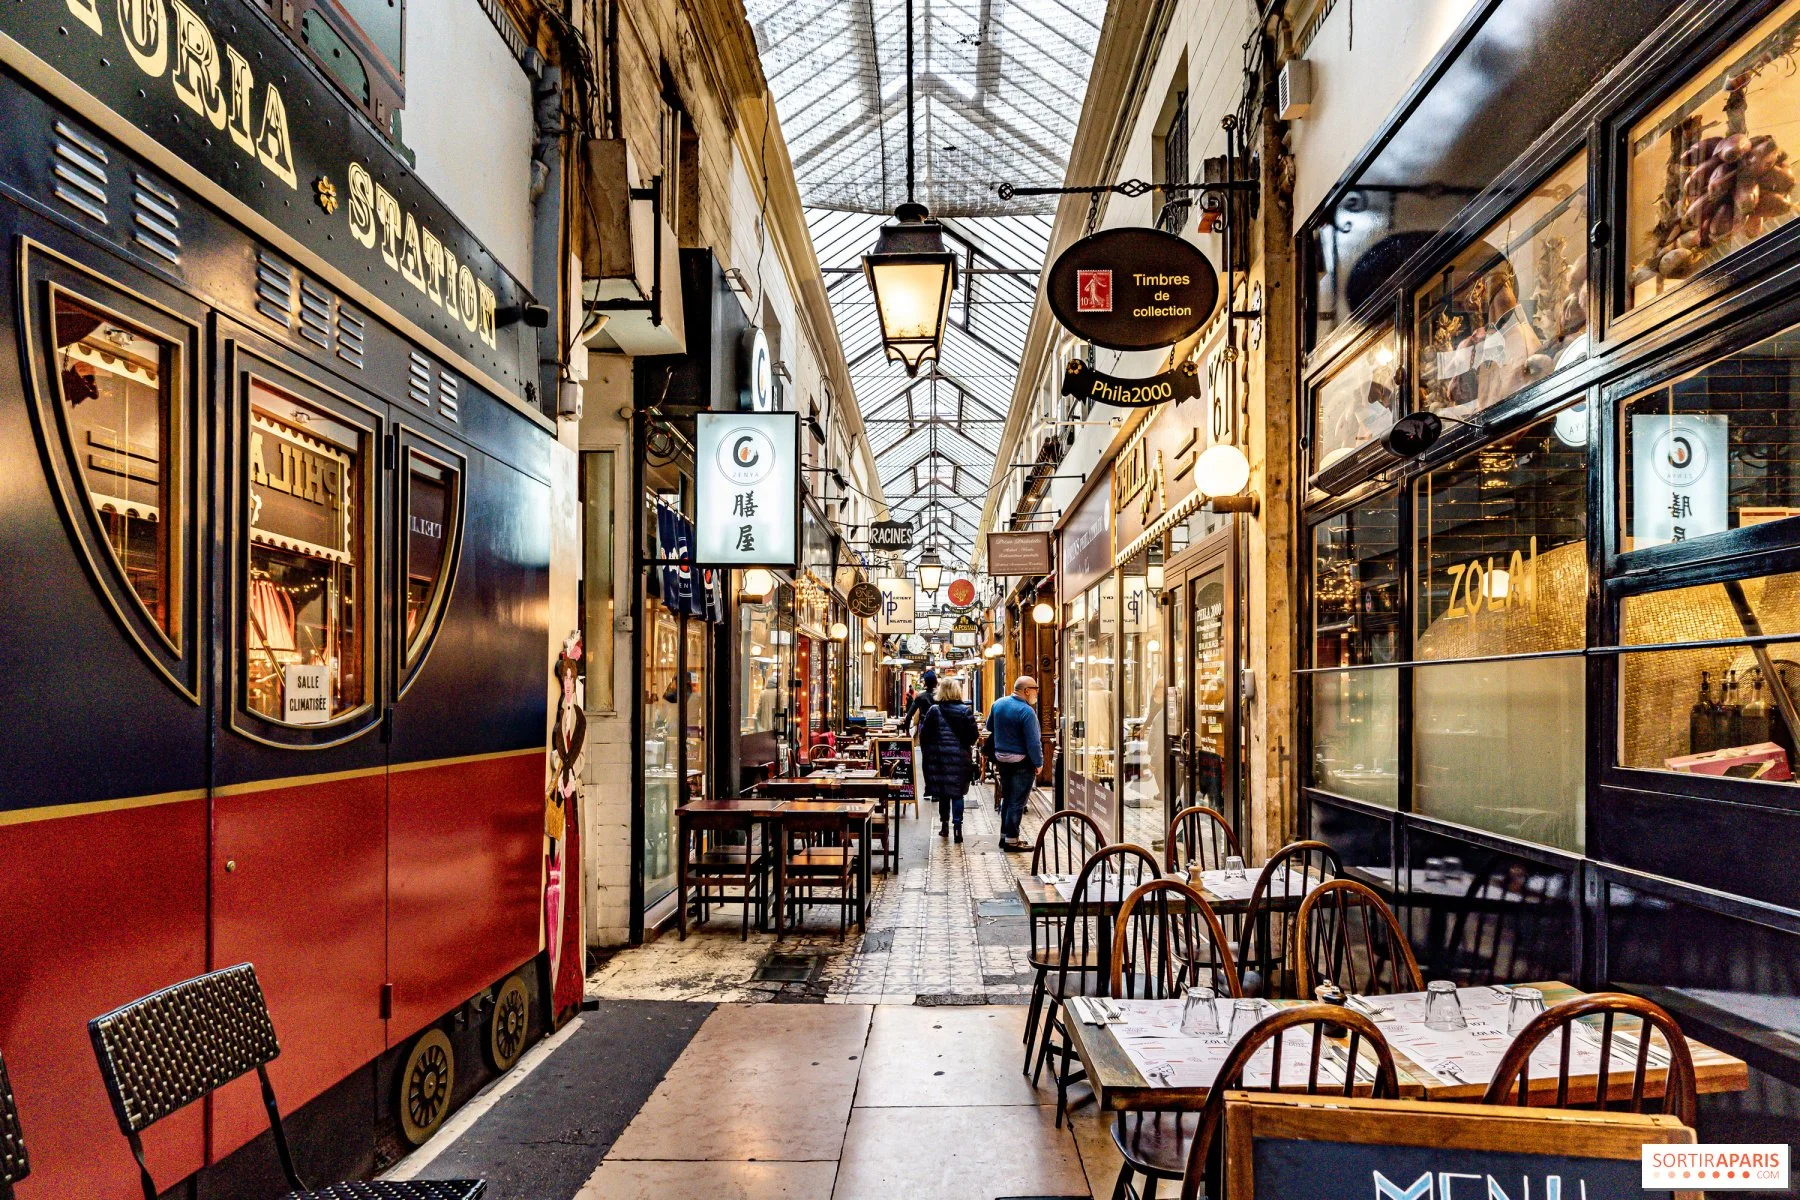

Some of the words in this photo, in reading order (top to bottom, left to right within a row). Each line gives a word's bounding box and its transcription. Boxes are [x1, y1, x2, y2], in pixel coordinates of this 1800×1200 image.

[348, 161, 496, 351] STATION
[1133, 273, 1190, 286] Timbres
[1154, 290, 1170, 301] de
[1133, 305, 1192, 317] collection
[1091, 380, 1172, 403] Phila2000
[1117, 437, 1148, 514] PHILA
[733, 490, 759, 552] 膳屋
[871, 528, 913, 544] RACINES
[297, 676, 319, 688] SALLE
[290, 694, 327, 711] CLIMATISÉE
